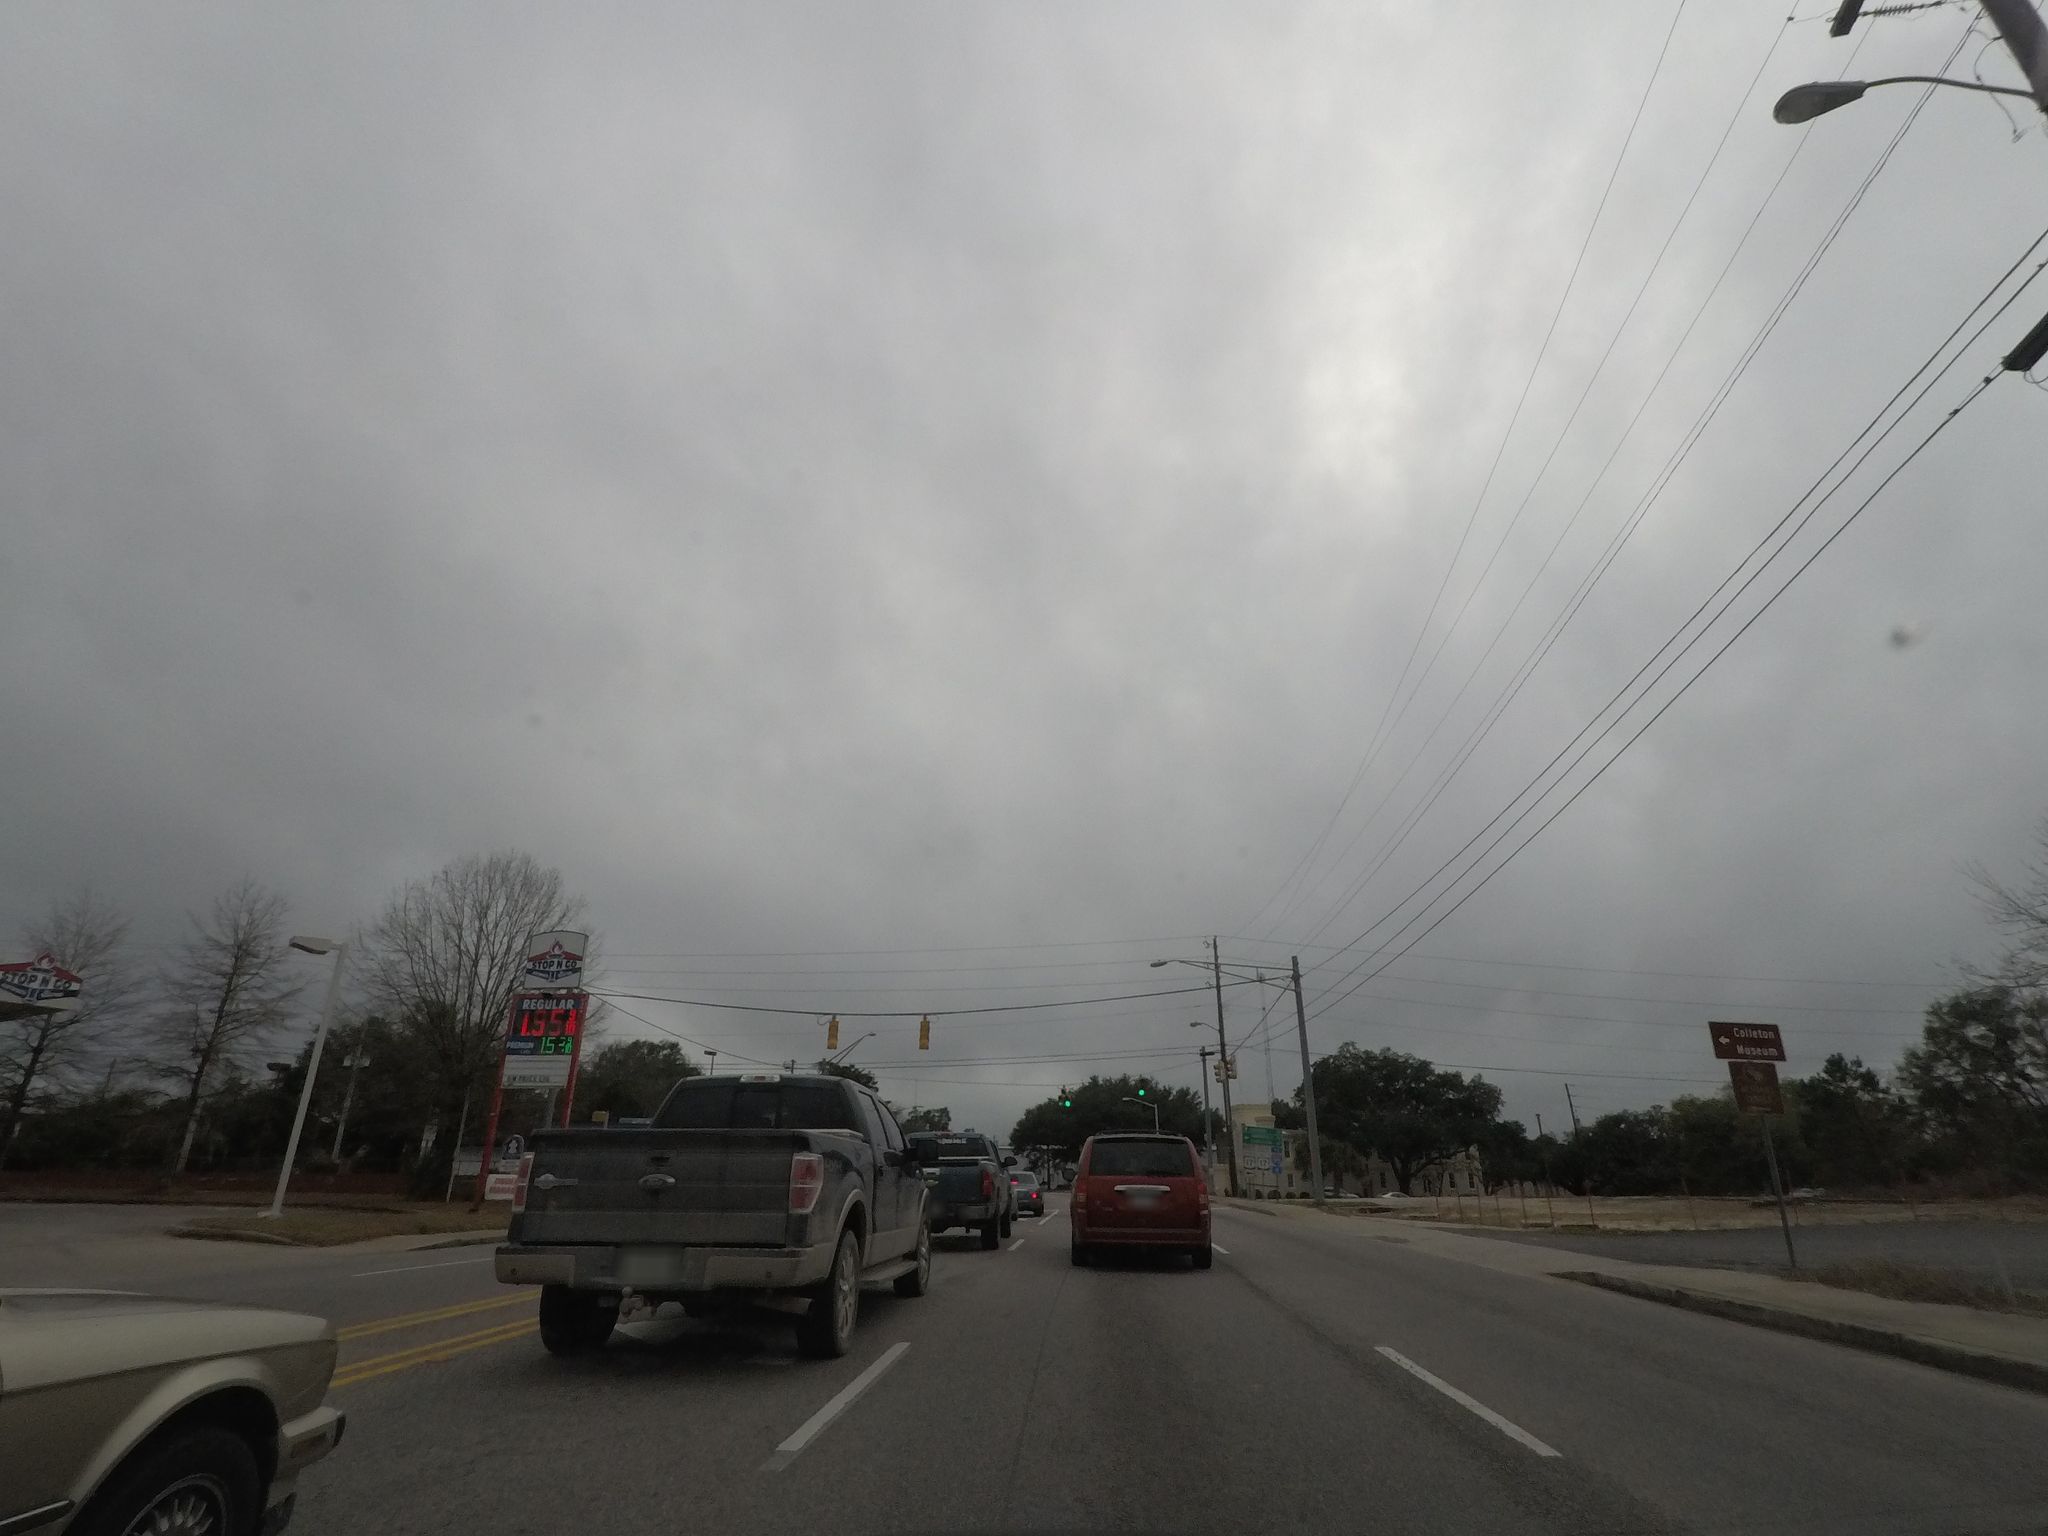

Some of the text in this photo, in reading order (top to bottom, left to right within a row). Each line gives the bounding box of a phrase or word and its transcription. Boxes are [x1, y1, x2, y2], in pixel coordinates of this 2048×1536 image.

[532, 960, 555, 969] STOP
[556, 960, 564, 969] N
[523, 999, 574, 1010] REGULAR
[1733, 1028, 1775, 1039] Colleton
[1737, 1045, 1777, 1055] Museum
